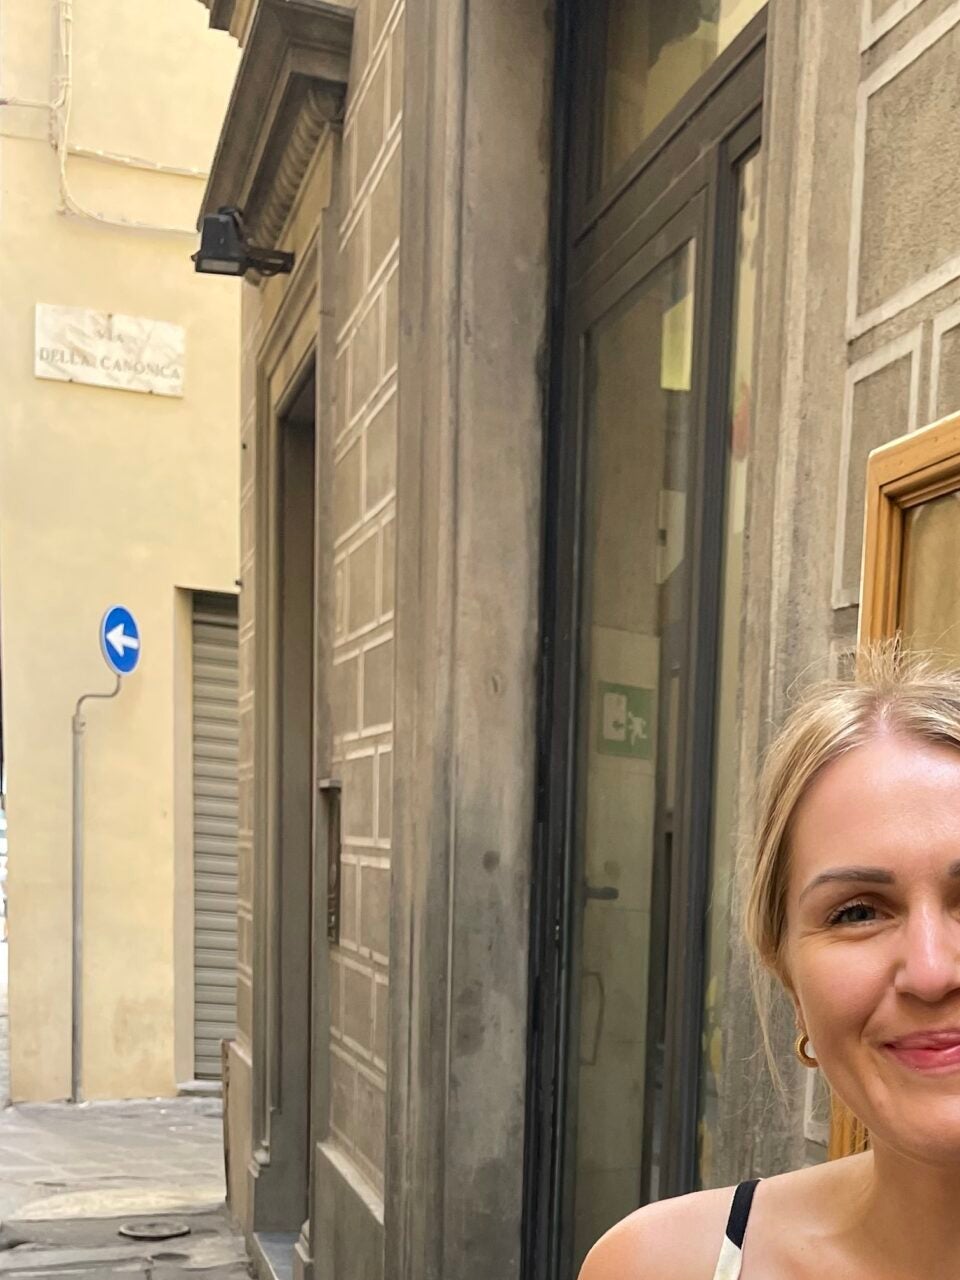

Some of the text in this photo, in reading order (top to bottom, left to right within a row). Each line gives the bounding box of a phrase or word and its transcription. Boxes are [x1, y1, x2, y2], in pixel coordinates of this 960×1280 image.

[95, 327, 125, 343] VIA
[40, 347, 180, 379] DELLA CANONICA
